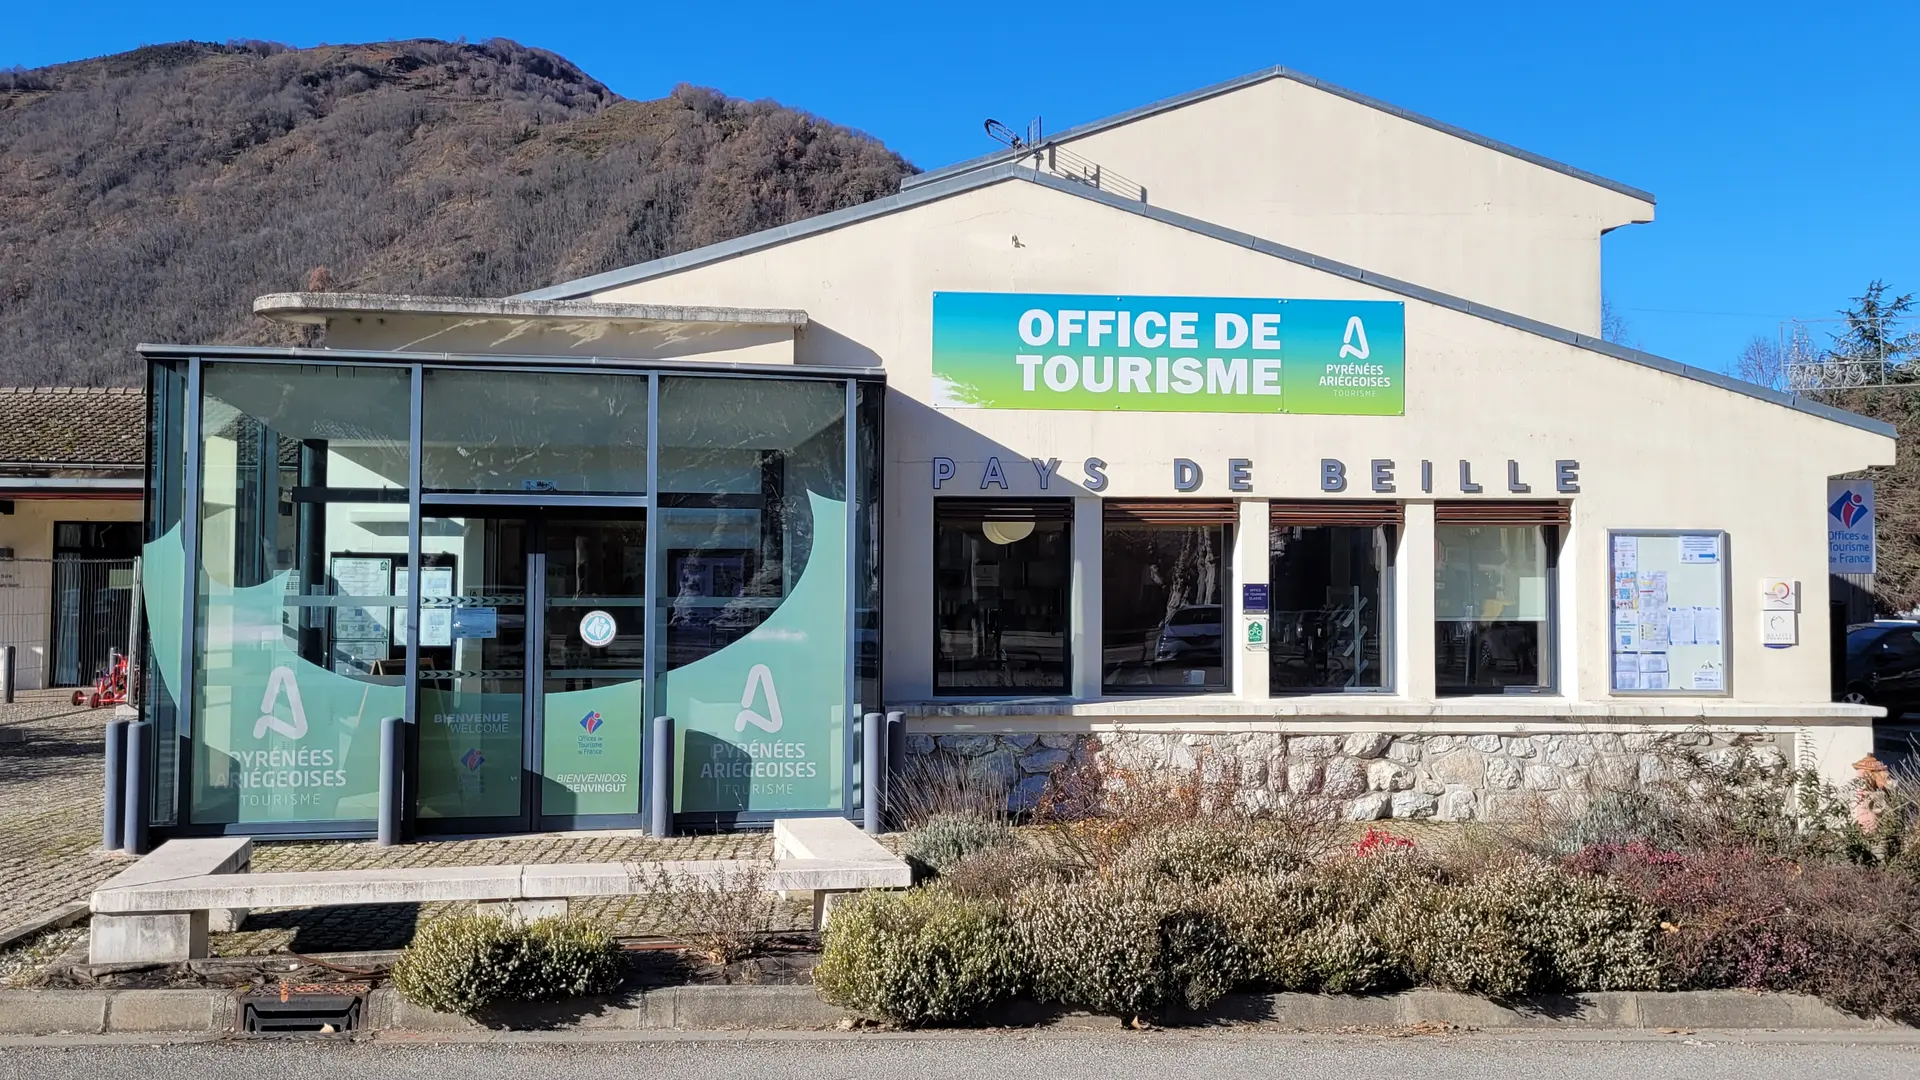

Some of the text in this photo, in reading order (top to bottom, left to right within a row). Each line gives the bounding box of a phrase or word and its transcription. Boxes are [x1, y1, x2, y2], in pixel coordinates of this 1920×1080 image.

[1018, 309, 1281, 350] OFFICE DE
[1015, 354, 1282, 395] TOURISME
[1326, 362, 1384, 375] PYRÉNÉES
[1319, 373, 1391, 387] ARIÉGEOISES
[1333, 389, 1377, 397] TOURISME
[933, 457, 1580, 493] PAYS DE BEILLE
[1828, 530, 1869, 541] Offices de
[1829, 541, 1870, 552] Tourisme
[1840, 553, 1870, 563] France
[434, 713, 509, 723] BIENVENUE
[450, 723, 509, 733] WELCOME
[578, 741, 602, 749] Tourisme
[712, 739, 806, 760] PYRÉNÉES
[229, 746, 334, 768] PYRÉNÉES
[700, 759, 817, 779] ARIÉGEOISES
[214, 767, 347, 789] ARIÉGEOISES
[557, 773, 627, 783] BIENVENIDOS
[566, 783, 627, 793] BENVINGUT
[724, 783, 794, 795] TOURISME
[240, 793, 321, 807] TOURISME
